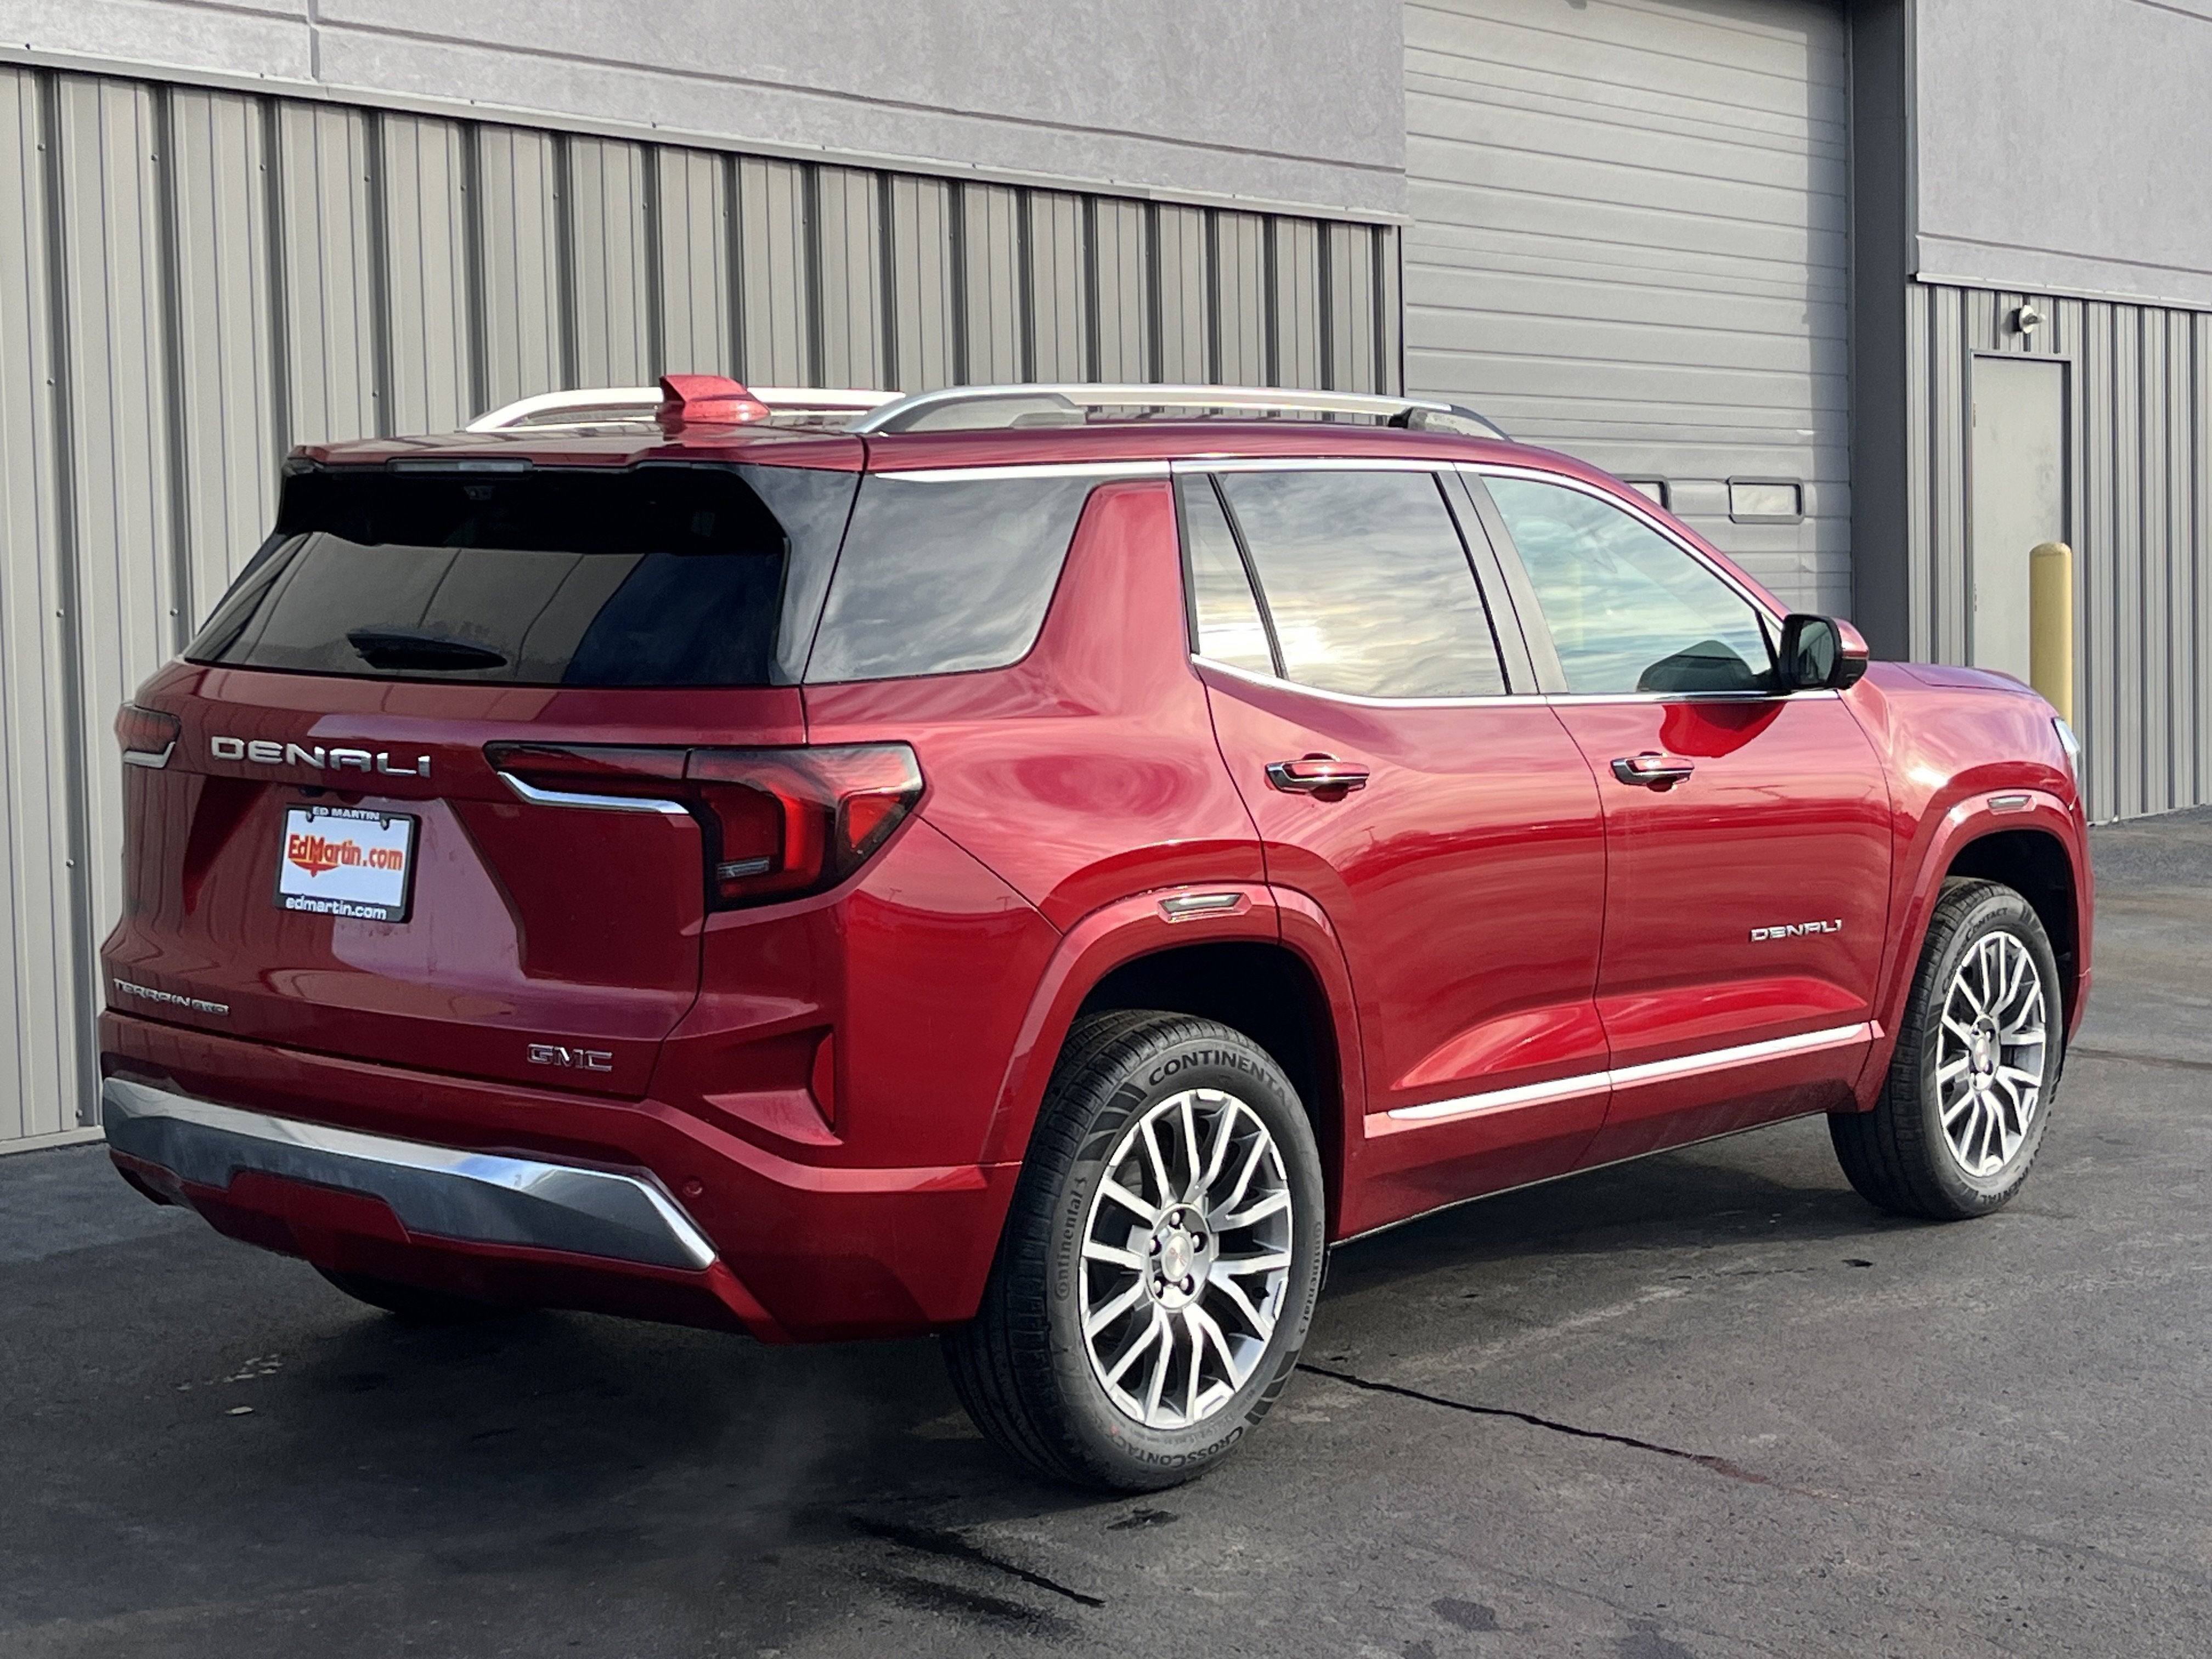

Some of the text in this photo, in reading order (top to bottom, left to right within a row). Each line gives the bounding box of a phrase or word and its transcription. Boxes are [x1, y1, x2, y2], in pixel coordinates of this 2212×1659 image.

[211, 736, 430, 778] DENALI
[313, 806, 380, 820] ED MARTIN
[285, 894, 387, 920] edmartin.com
[1751, 919, 1842, 942] DENALI
[113, 978, 190, 1007] TERRAIN
[527, 1043, 613, 1071] GMC
